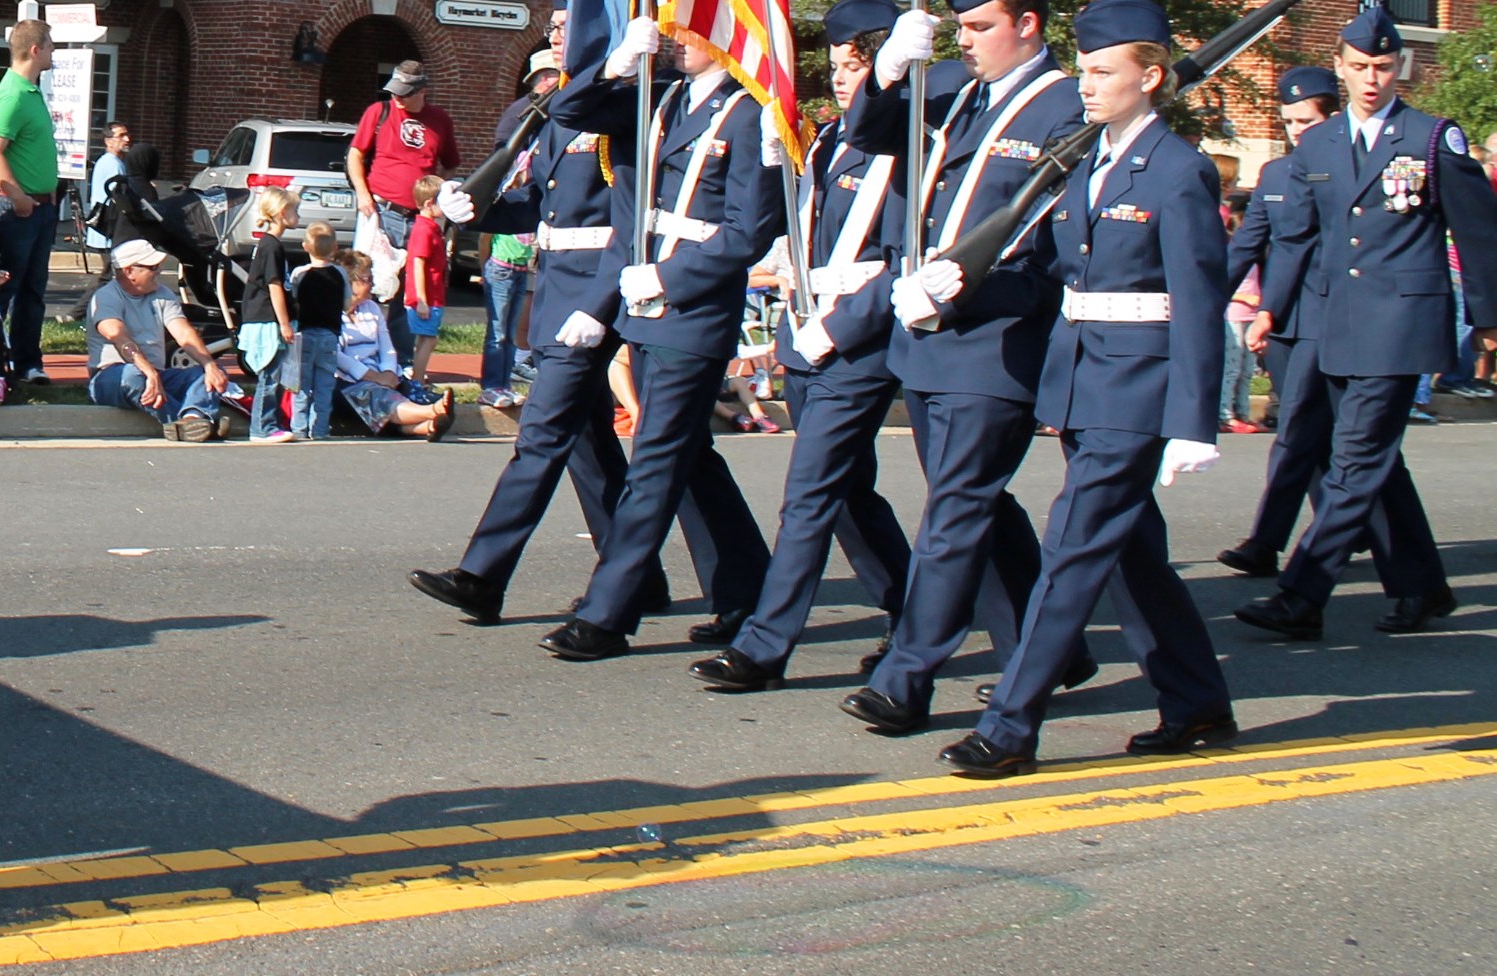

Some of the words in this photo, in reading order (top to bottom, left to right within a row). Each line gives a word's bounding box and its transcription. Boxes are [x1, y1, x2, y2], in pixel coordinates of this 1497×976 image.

[448, 6, 487, 17] Haymarket
[490, 9, 518, 20] Bicycles
[73, 57, 84, 70] For
[52, 74, 76, 88] LEASE
